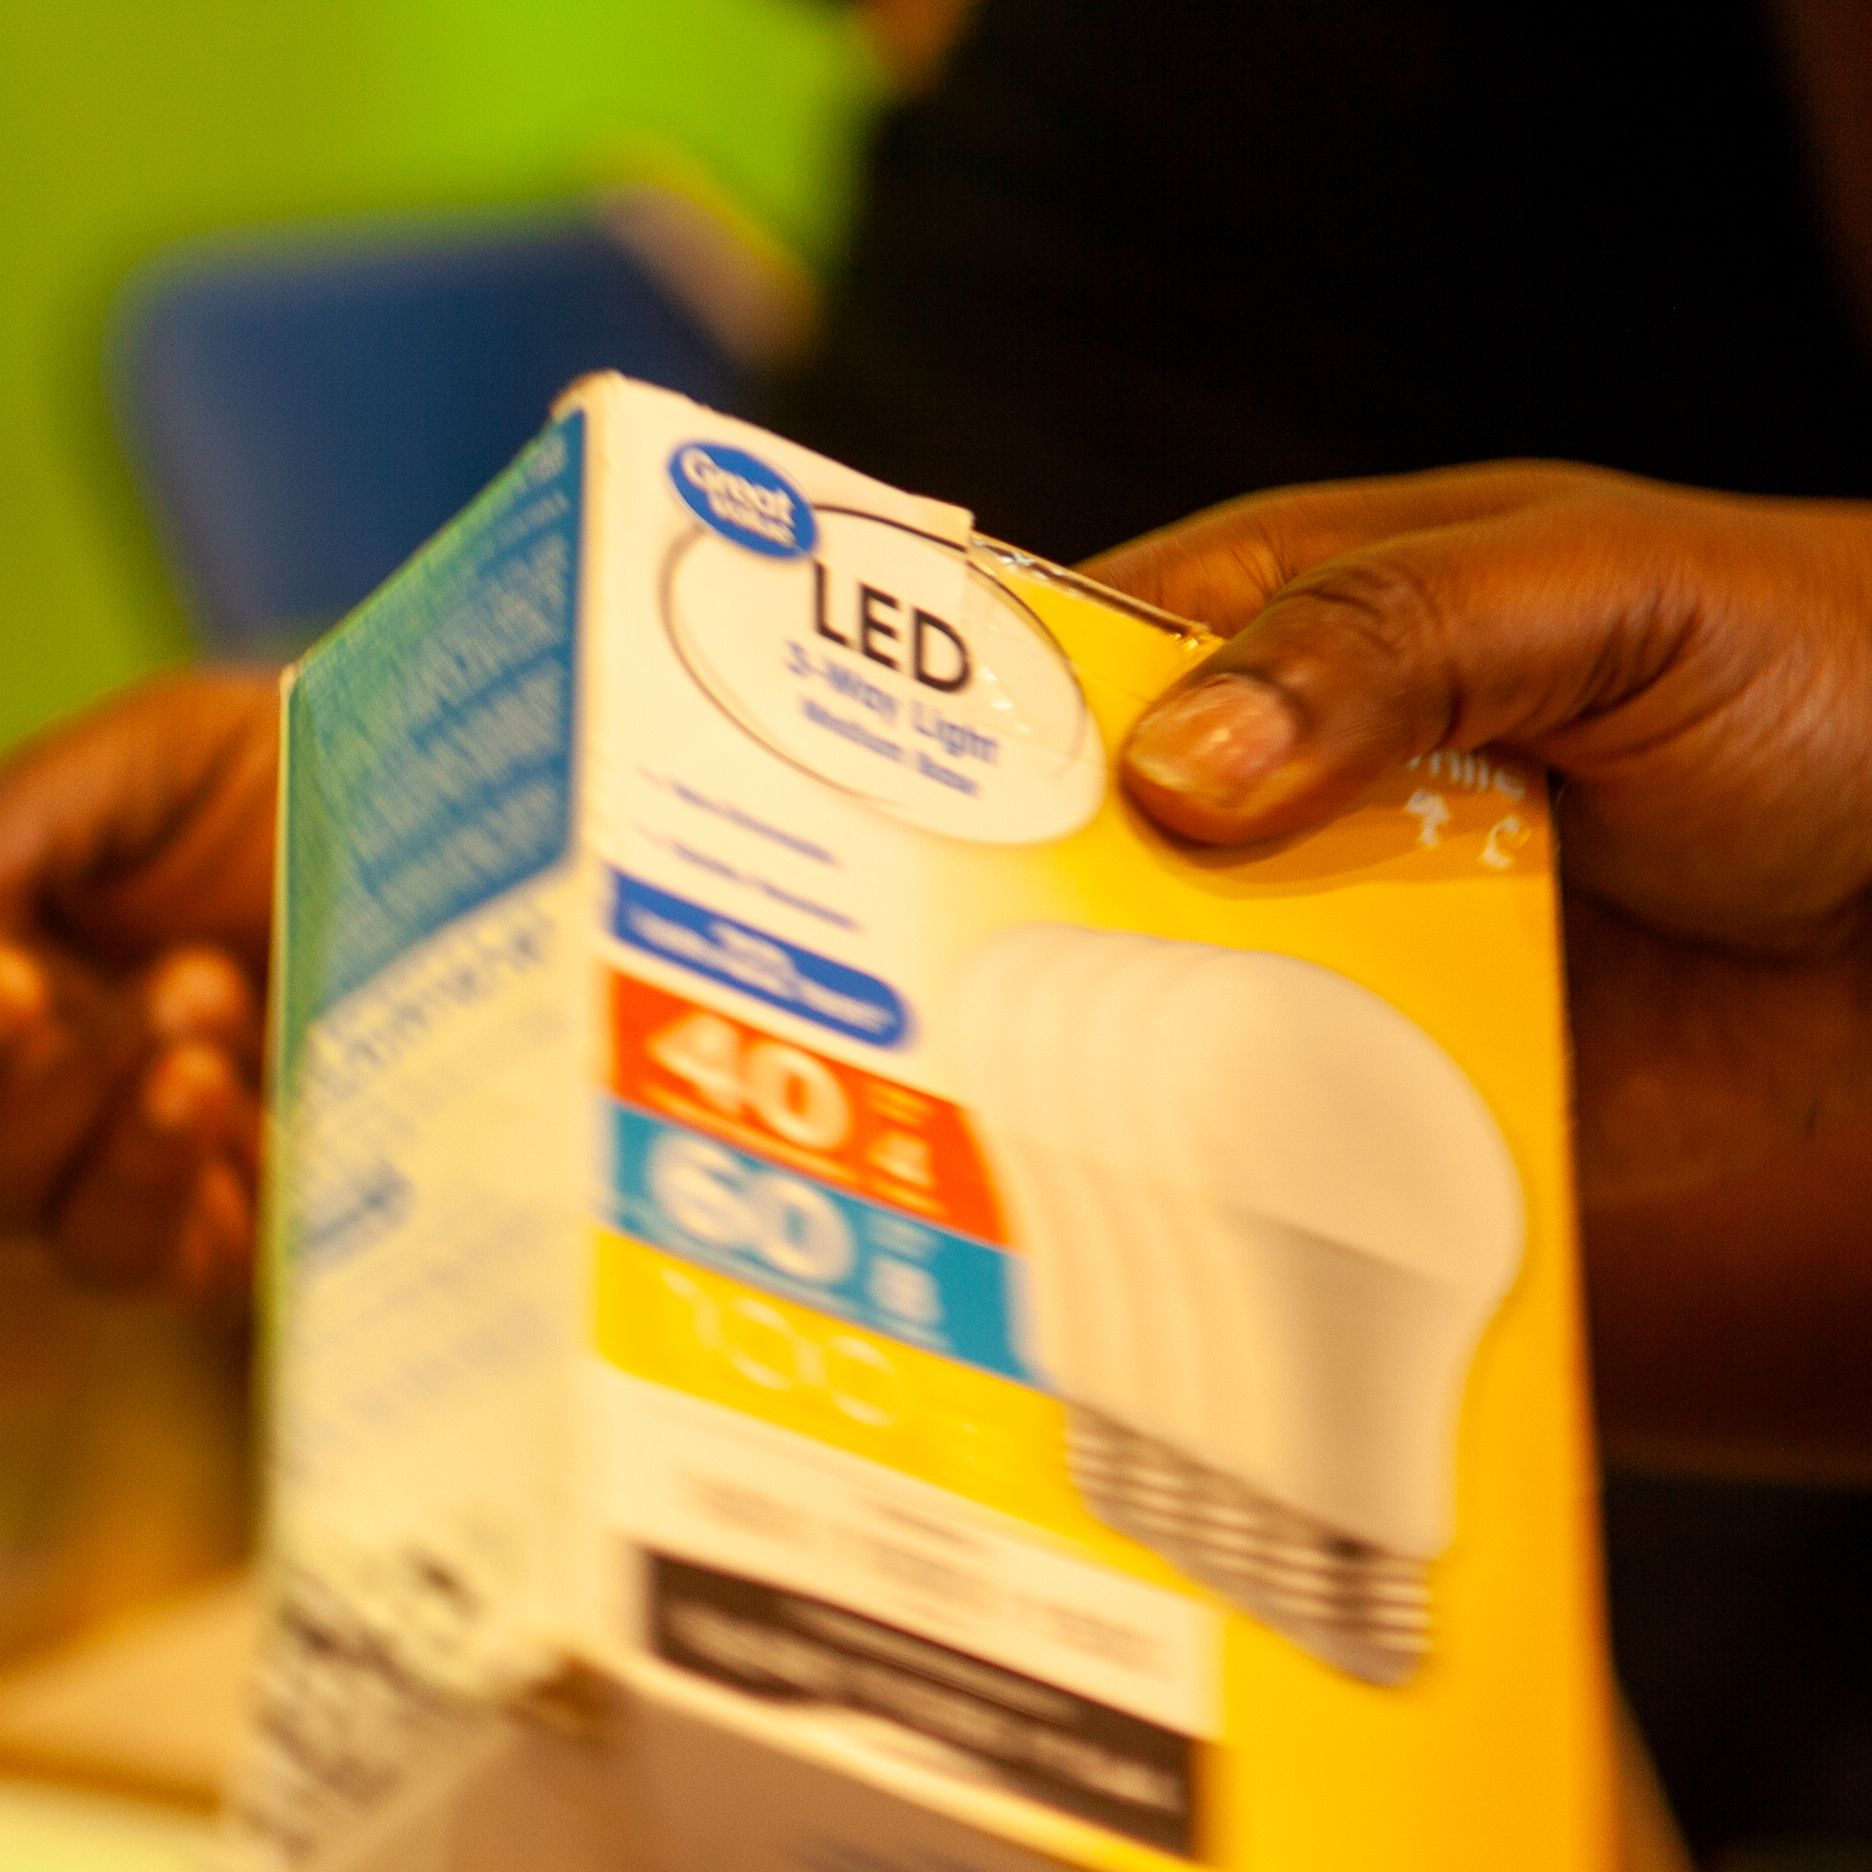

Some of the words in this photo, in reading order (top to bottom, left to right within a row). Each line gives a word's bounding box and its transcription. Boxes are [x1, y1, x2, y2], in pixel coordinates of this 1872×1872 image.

[680, 446, 797, 528] Great
[812, 559, 971, 694] LED
[911, 699, 1000, 767] Light
[647, 1011, 851, 1152] 40
[647, 1128, 853, 1284] 60
